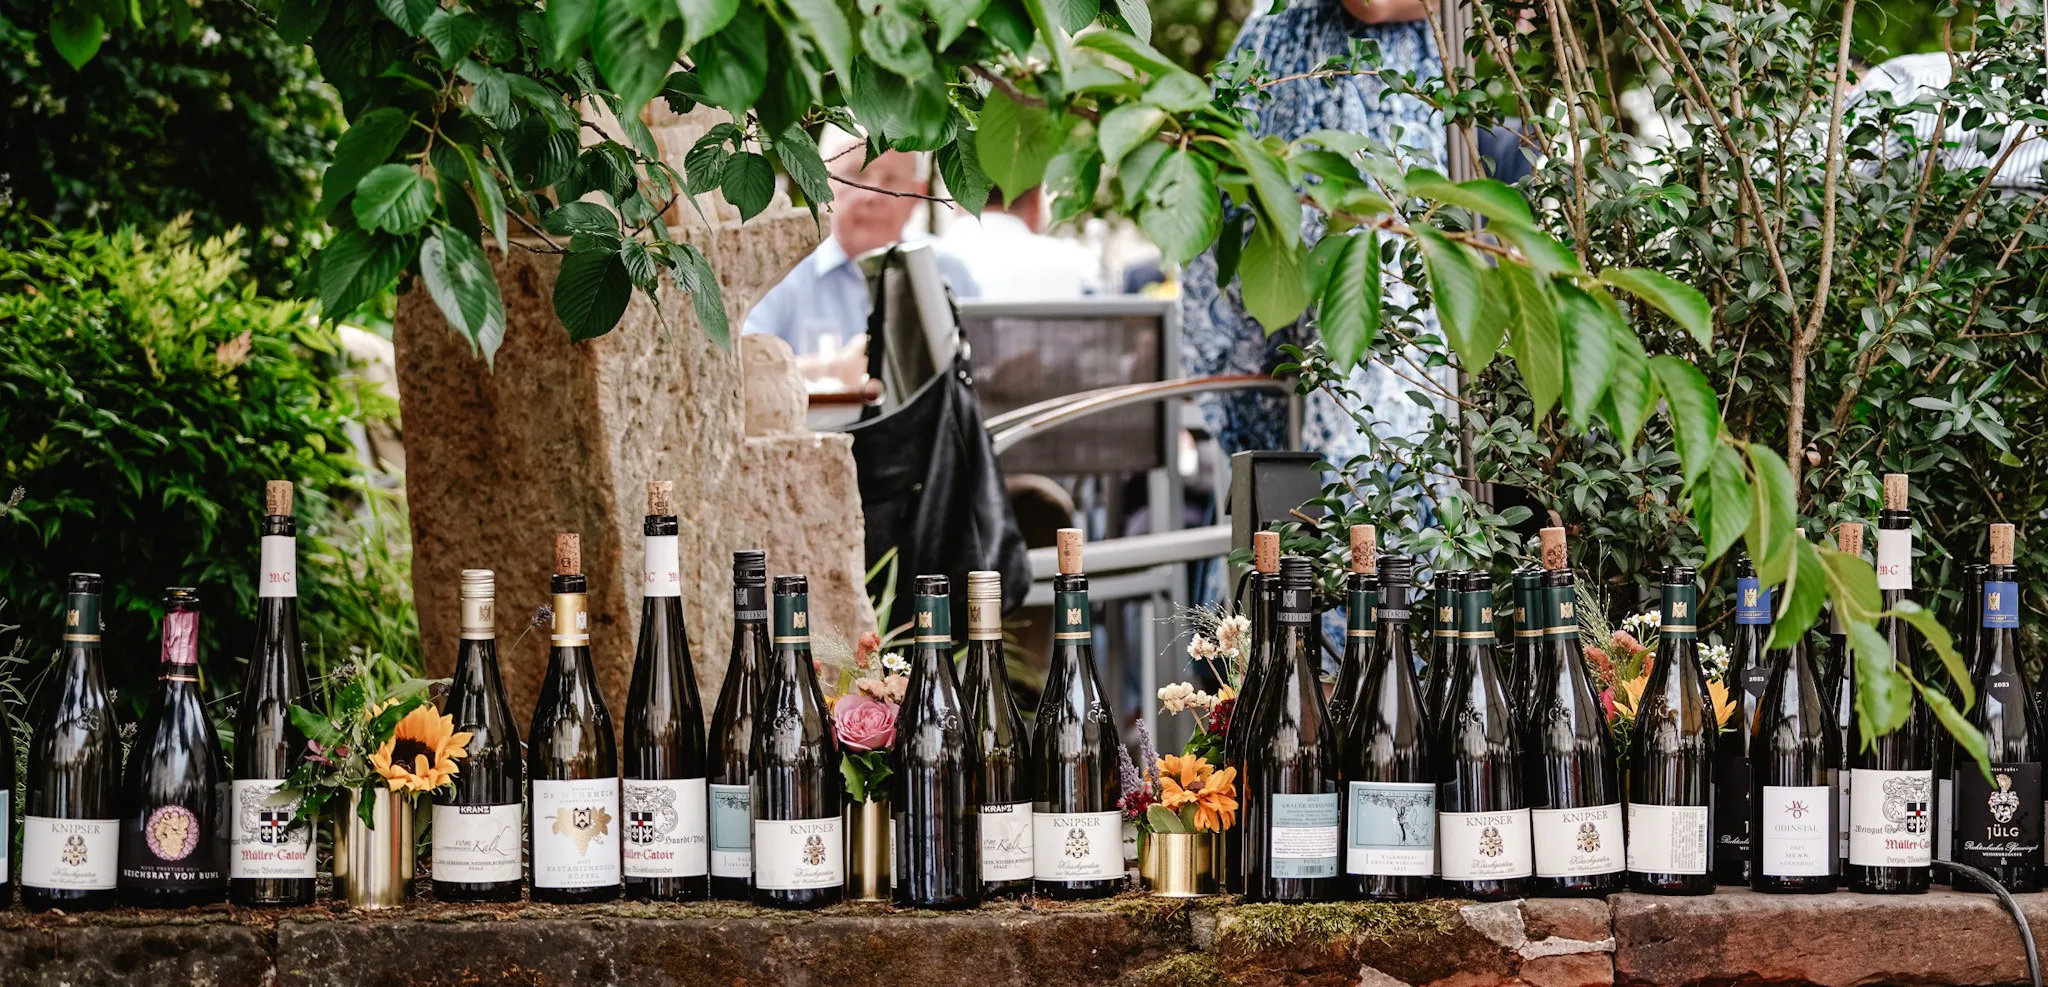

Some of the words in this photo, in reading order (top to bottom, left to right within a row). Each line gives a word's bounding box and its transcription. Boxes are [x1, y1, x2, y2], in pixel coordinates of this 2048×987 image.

[460, 806, 490, 814] KRANZ
[984, 805, 1012, 813] KRANZ
[1466, 815, 1513, 827] KNIPSER
[1563, 810, 1609, 823] KNIPSER
[1053, 817, 1101, 828] KNIPSER
[1774, 824, 1819, 832] ODINSTAL
[51, 823, 101, 834] KNIPSER
[790, 823, 835, 834] KNIPSER
[1986, 824, 2020, 840] JÜLG
[241, 849, 306, 861] Müller-Catoir
[124, 869, 170, 880] REICHSRAT
[174, 872, 195, 880] VON
[199, 872, 219, 880] BUHL
